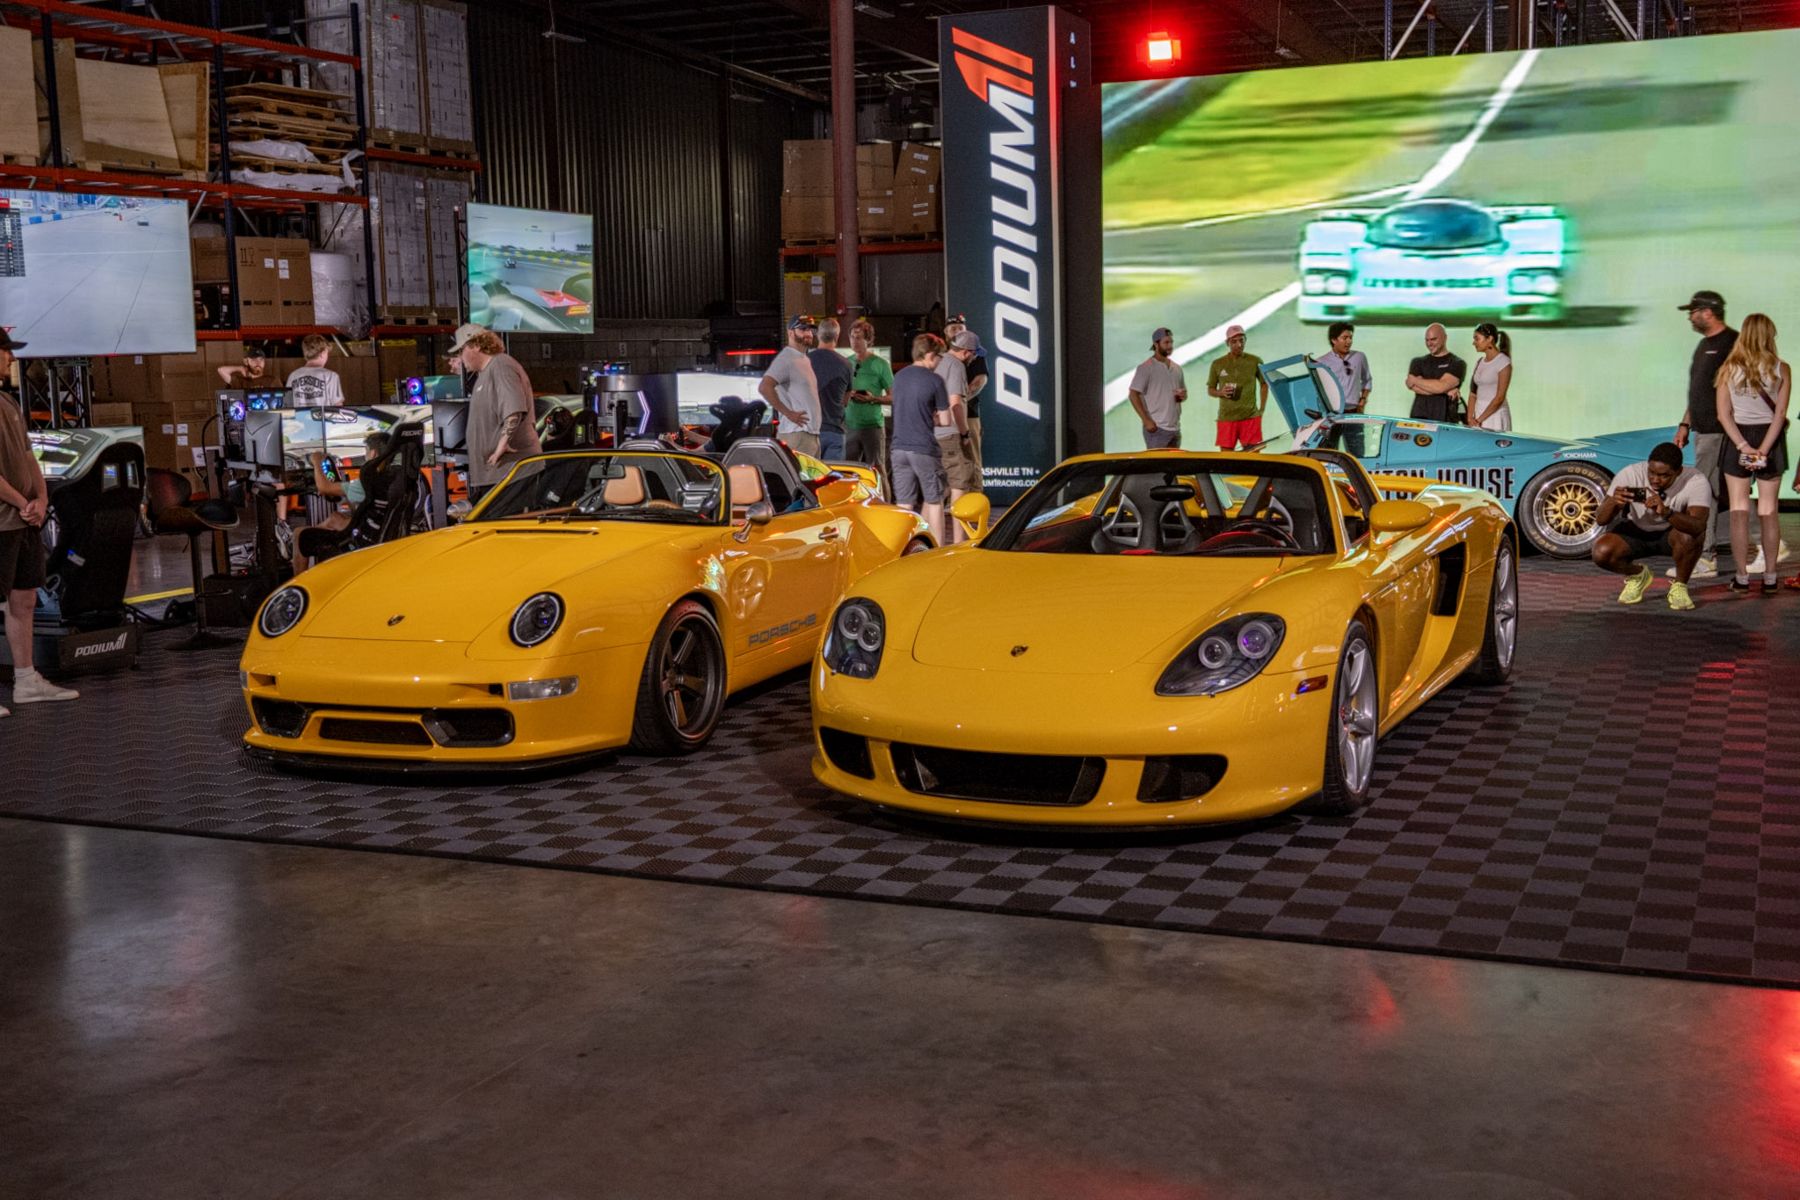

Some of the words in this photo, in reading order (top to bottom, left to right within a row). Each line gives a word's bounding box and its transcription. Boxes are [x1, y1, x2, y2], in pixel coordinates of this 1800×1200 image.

[980, 467, 1020, 476] ASHVILLE
[1021, 466, 1034, 476] TN
[748, 613, 817, 648] PORSCHE
